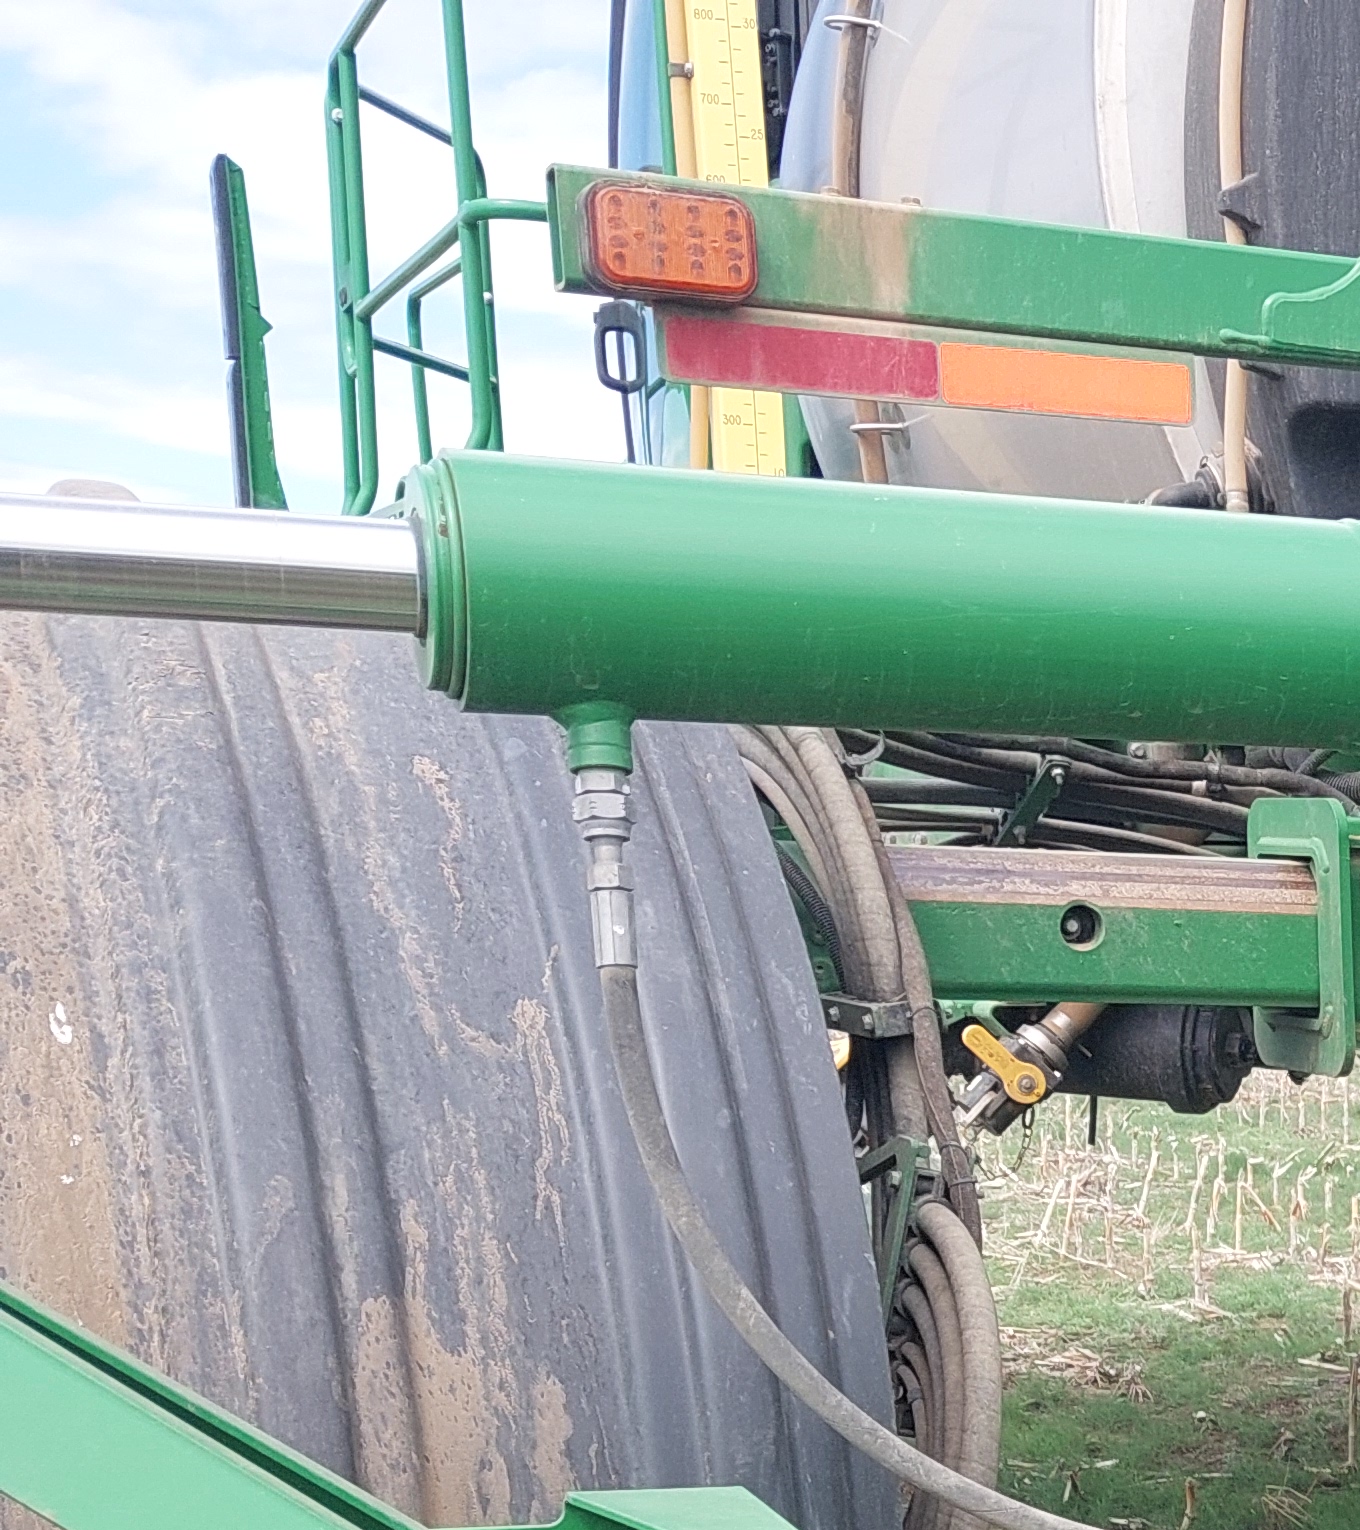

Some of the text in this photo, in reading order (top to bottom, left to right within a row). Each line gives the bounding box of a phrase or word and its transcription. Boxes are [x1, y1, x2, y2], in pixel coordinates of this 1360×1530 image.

[693, 8, 714, 20] 800
[742, 18, 756, 29] 30
[700, 93, 720, 105] 700
[750, 128, 764, 140] 25
[722, 413, 742, 426] 300
